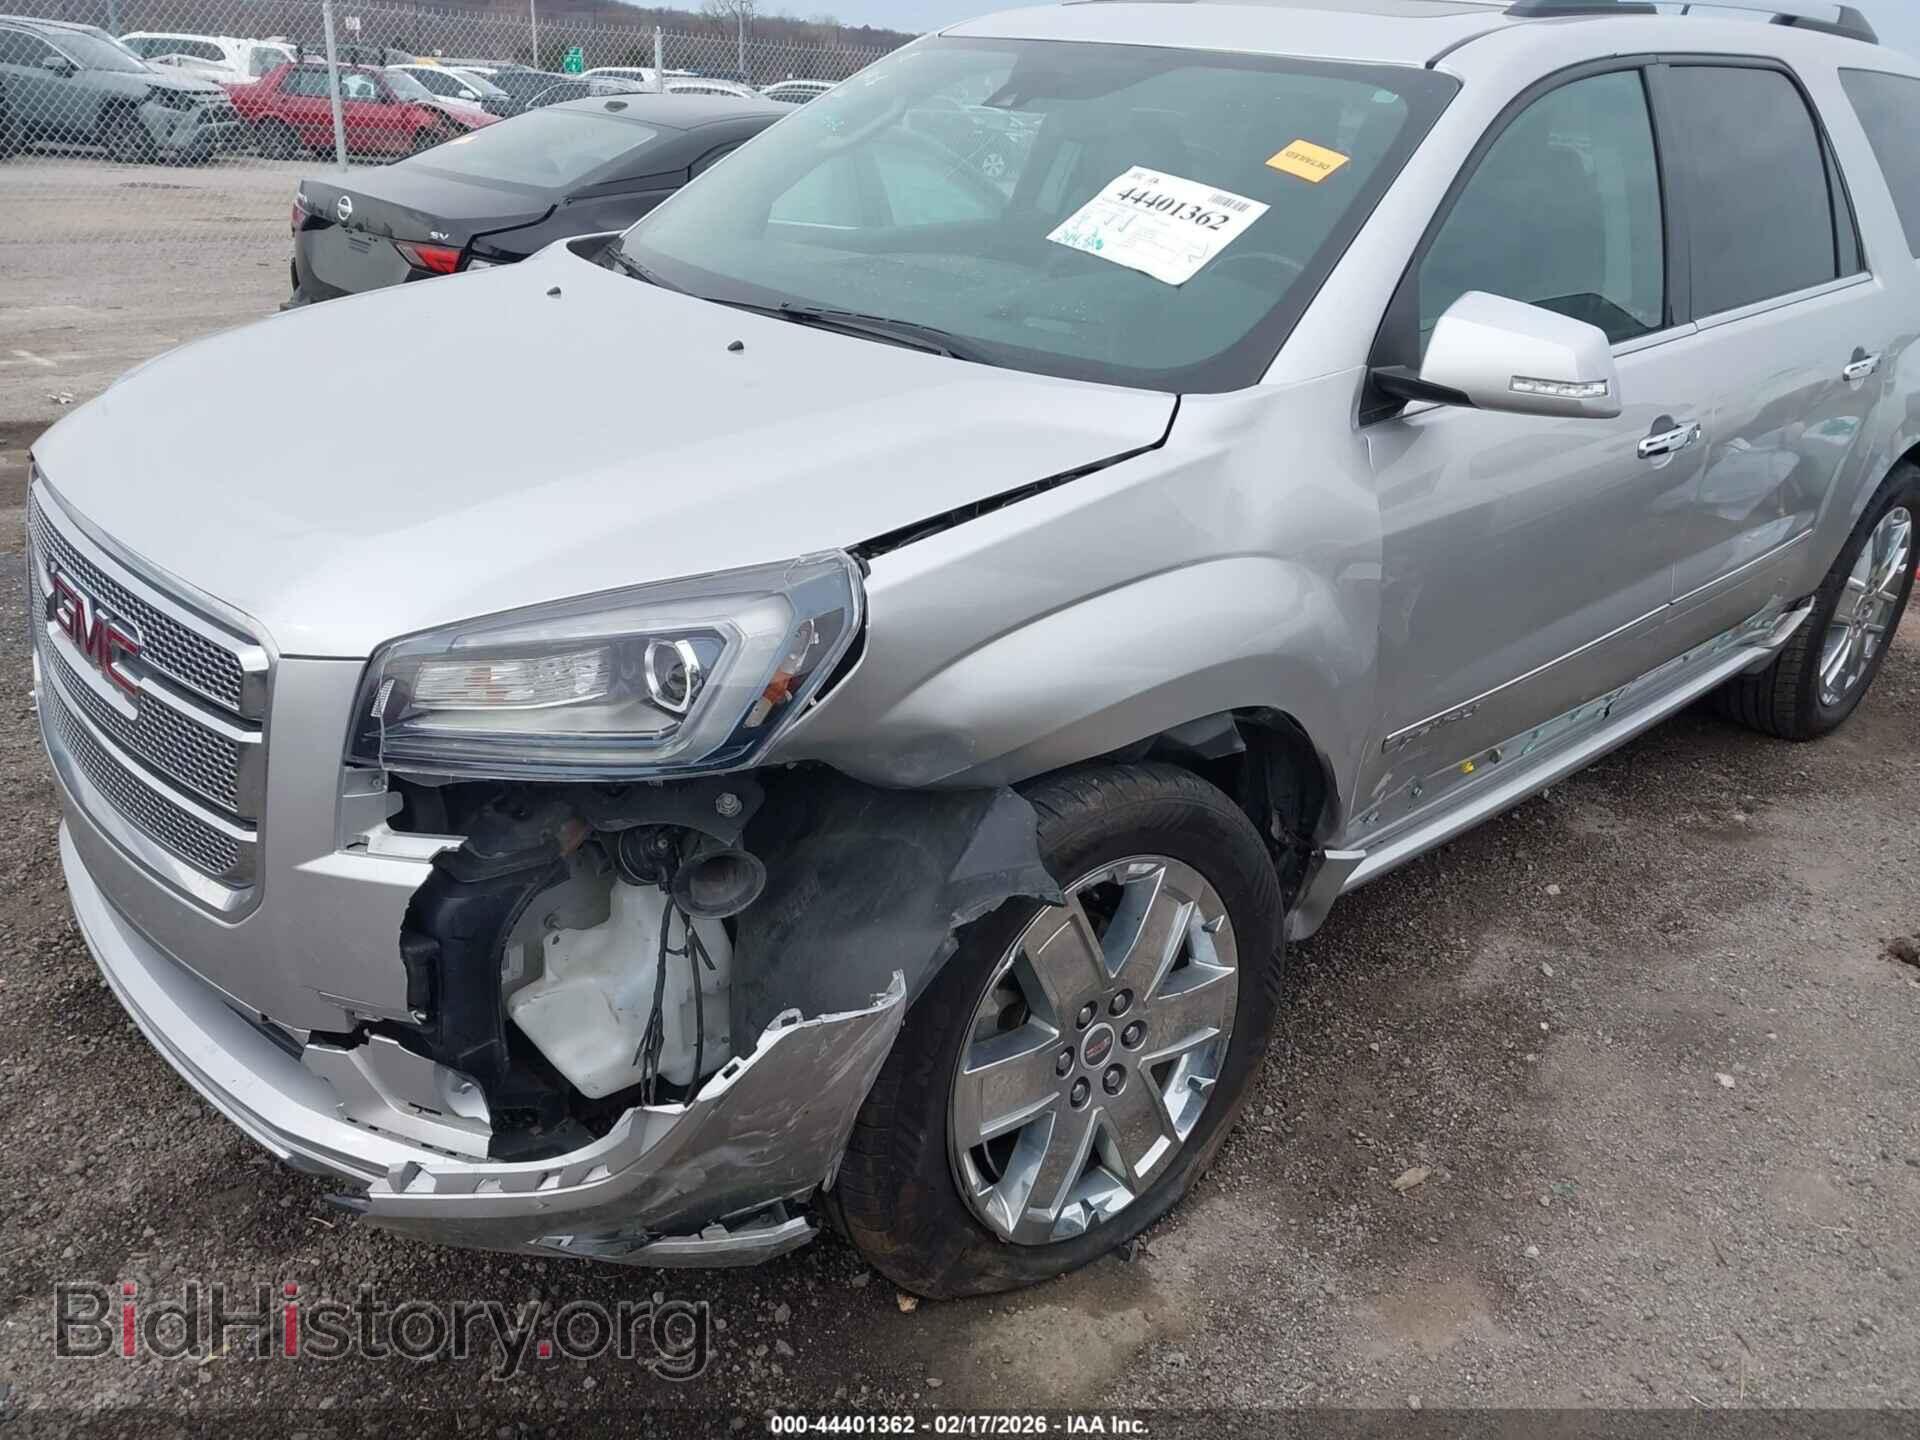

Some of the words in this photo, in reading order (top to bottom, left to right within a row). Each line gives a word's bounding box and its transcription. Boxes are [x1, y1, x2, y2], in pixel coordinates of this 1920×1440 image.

[1116, 186, 1230, 231] 44401362
[430, 231, 449, 241] SV
[53, 569, 142, 698] GMC
